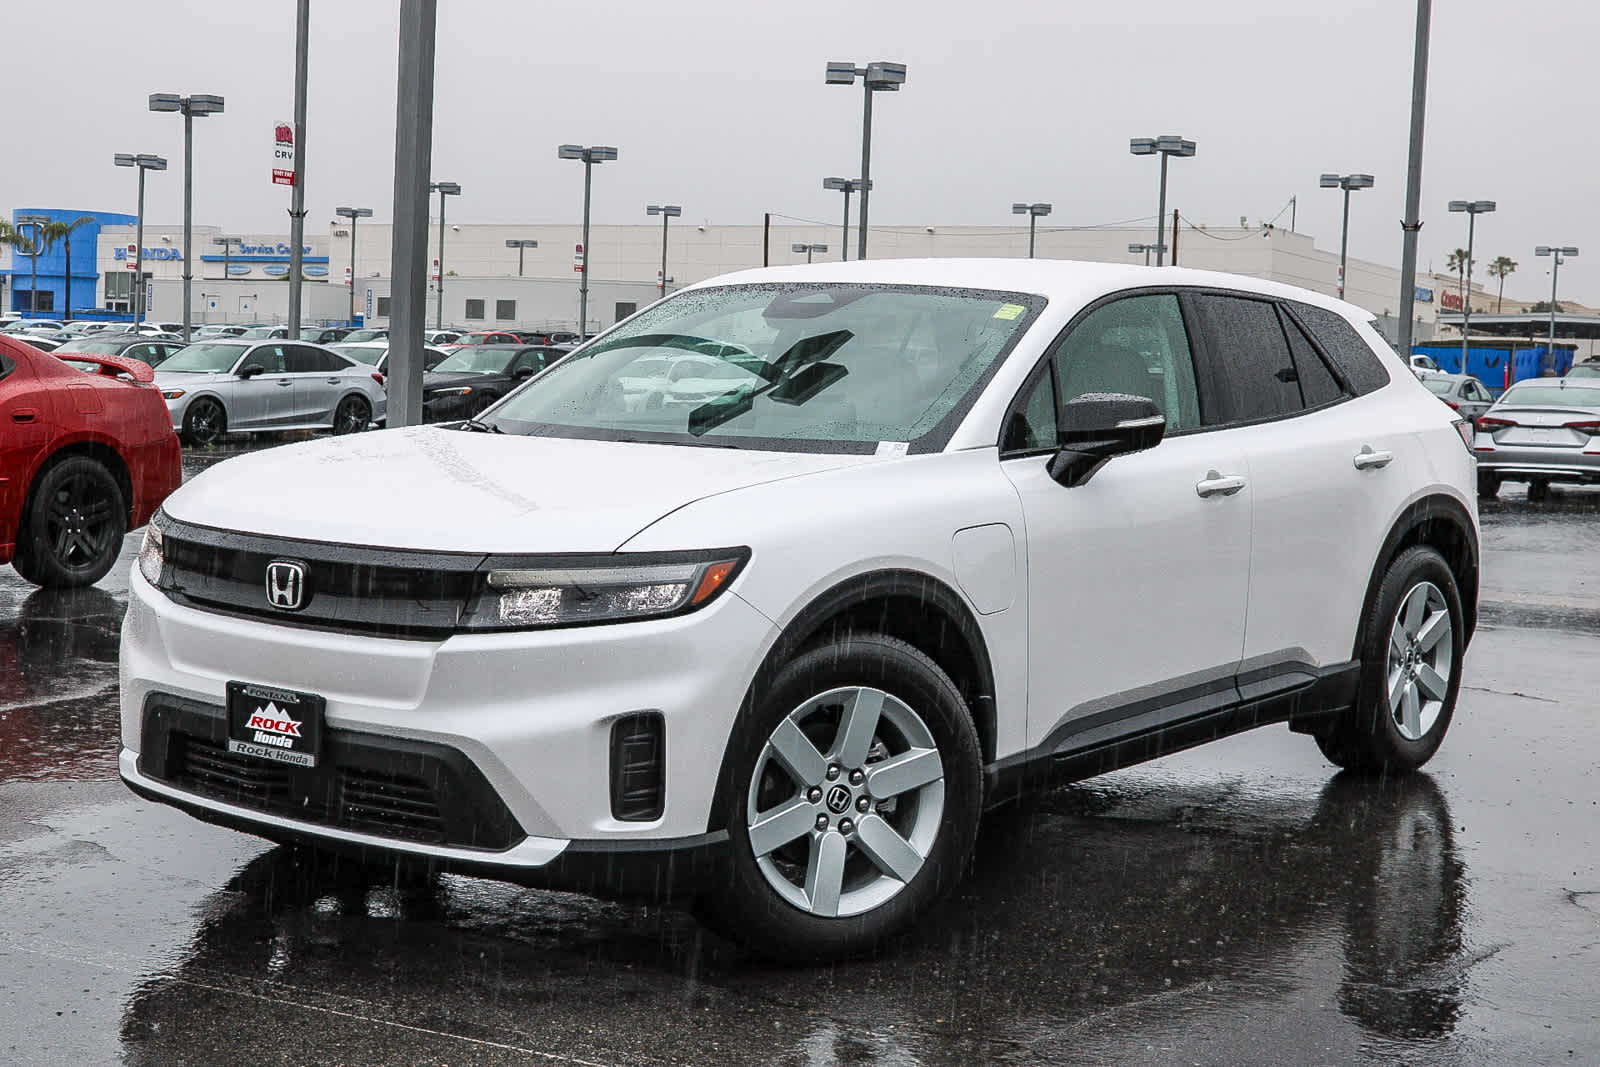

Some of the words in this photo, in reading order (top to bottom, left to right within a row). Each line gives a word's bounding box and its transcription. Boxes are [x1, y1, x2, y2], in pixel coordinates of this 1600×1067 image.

[275, 150, 293, 160] CRV
[113, 248, 184, 261] HNDA
[276, 243, 312, 254] Ceer
[248, 688, 295, 702] FONTANA
[251, 716, 297, 734] ROCK
[253, 731, 293, 748] Honda
[276, 751, 308, 765] Honda
